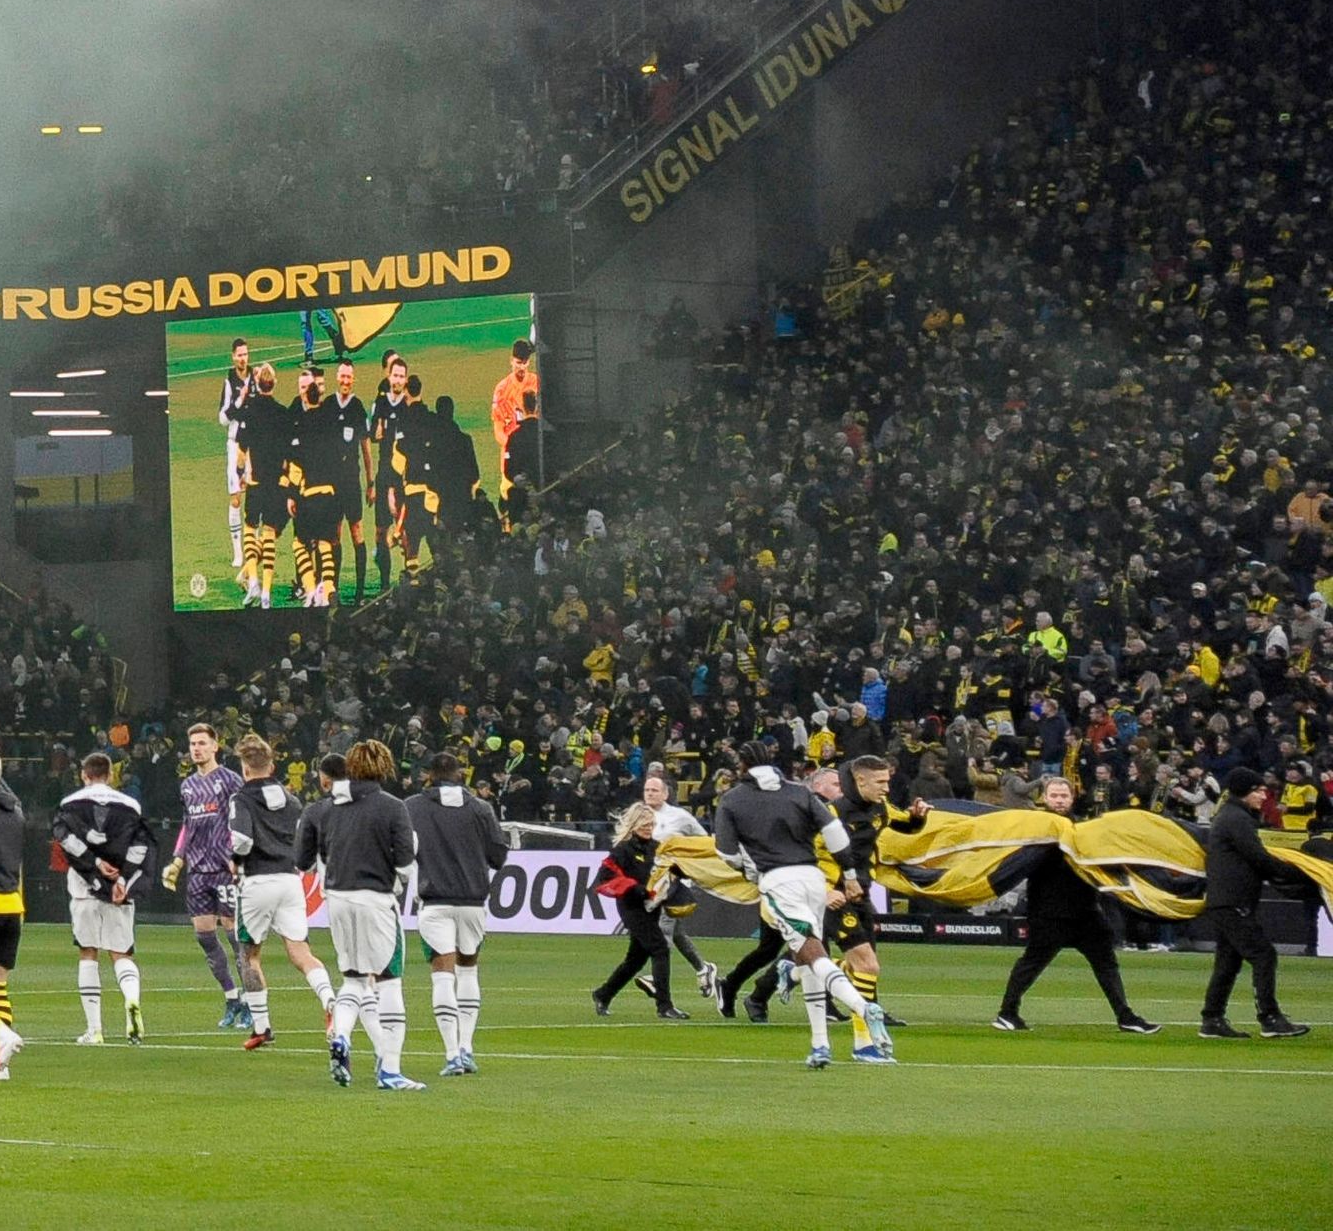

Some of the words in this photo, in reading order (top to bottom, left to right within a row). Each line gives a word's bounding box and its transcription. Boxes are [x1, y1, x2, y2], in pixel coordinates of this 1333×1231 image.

[620, 96, 759, 223] SIGNAL
[208, 244, 512, 307] DORTMUND
[945, 924, 1002, 935] BUNDESLIGA
